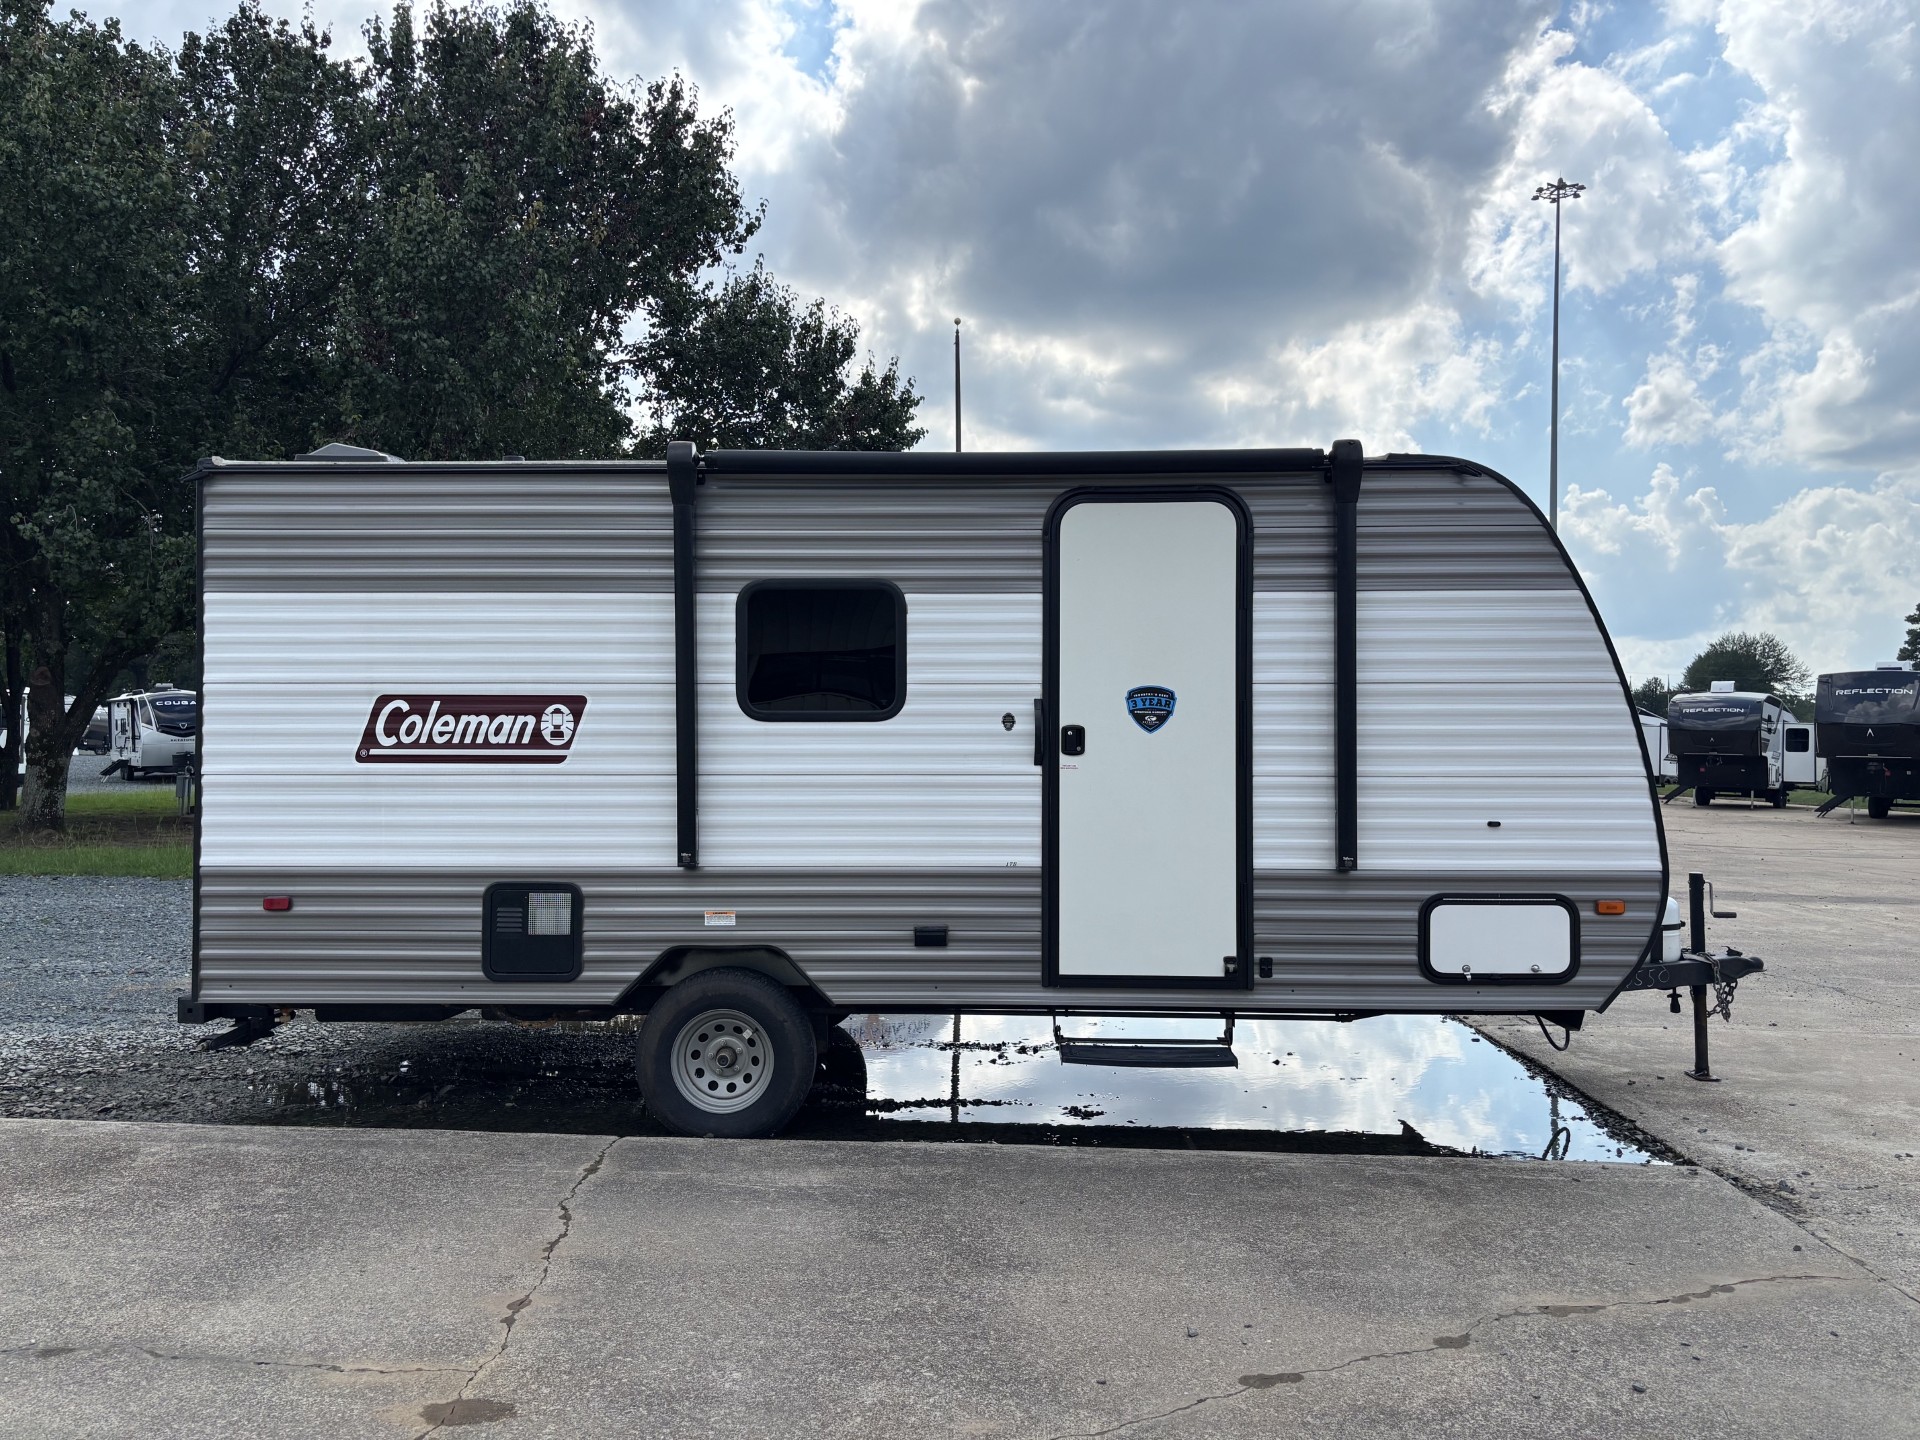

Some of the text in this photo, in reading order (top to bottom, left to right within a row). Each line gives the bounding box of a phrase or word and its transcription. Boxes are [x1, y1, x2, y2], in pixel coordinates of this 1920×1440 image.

[1835, 688, 1913, 696] REFLECTION
[1130, 697, 1172, 709] 3 YEAR
[375, 699, 535, 747] Coleman
